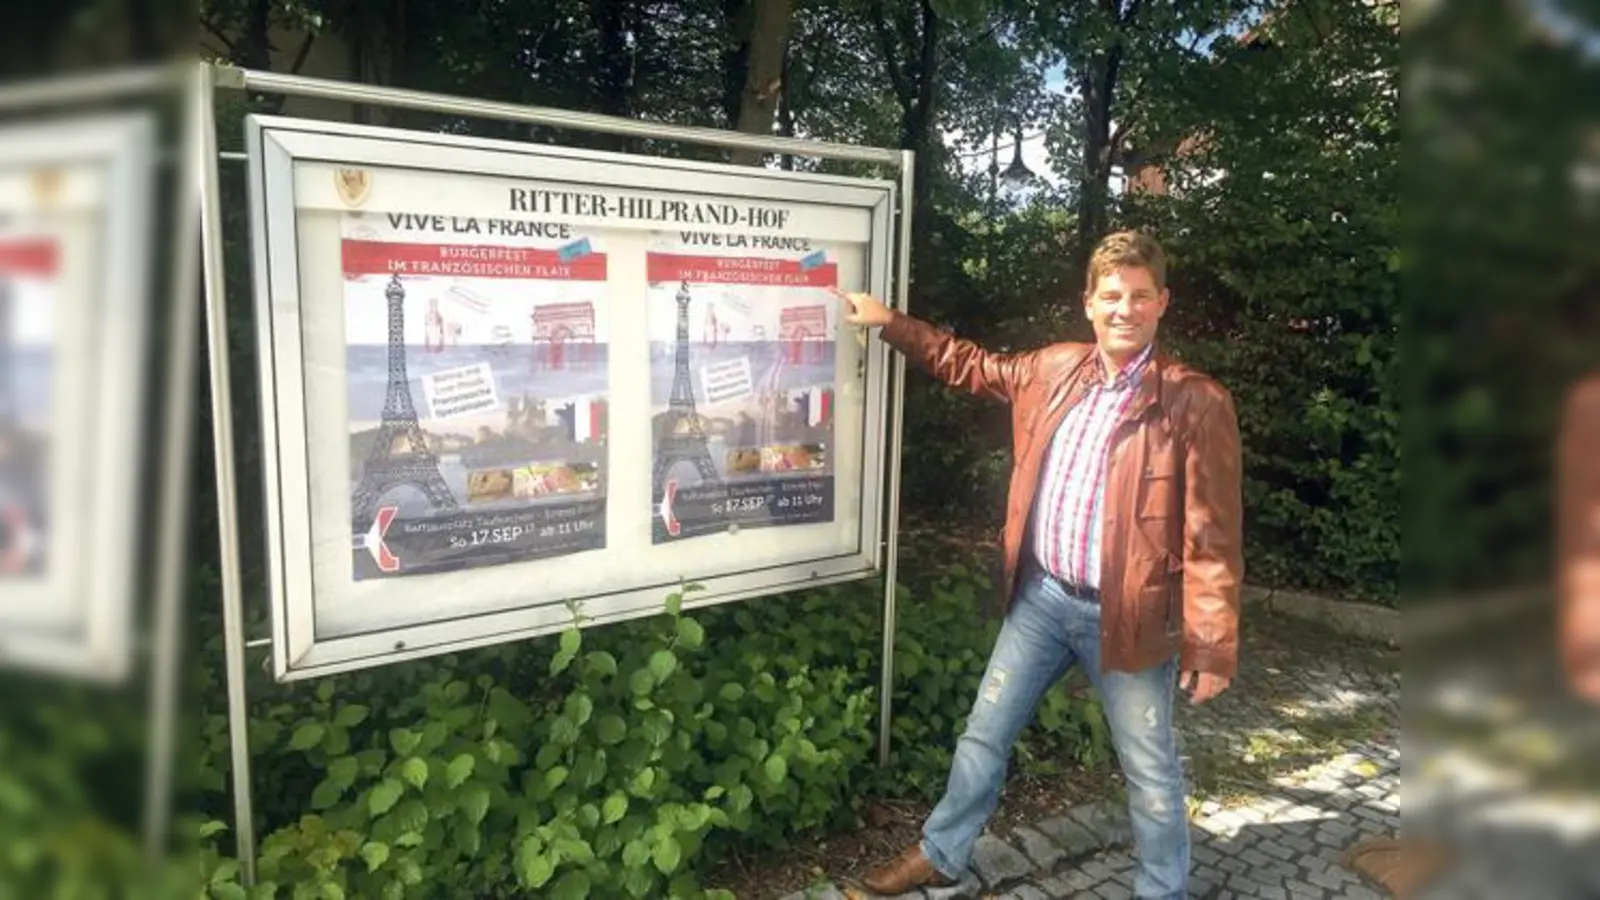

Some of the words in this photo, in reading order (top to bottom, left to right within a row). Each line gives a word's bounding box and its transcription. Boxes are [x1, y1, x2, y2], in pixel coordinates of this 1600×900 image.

[509, 187, 790, 229] RITTER-HILPRAND-HOF
[387, 213, 445, 232] VIVE
[453, 217, 481, 234] LA
[488, 219, 571, 239] FRANCE
[680, 231, 721, 245] VIVE
[726, 233, 748, 248] LA
[752, 235, 811, 251] FRANCE
[388, 260, 407, 271] IM
[535, 265, 570, 277] FLAIR
[449, 536, 467, 549] So
[539, 526, 555, 537] ab
[558, 522, 572, 535] 11
[574, 520, 595, 533] Uhr
